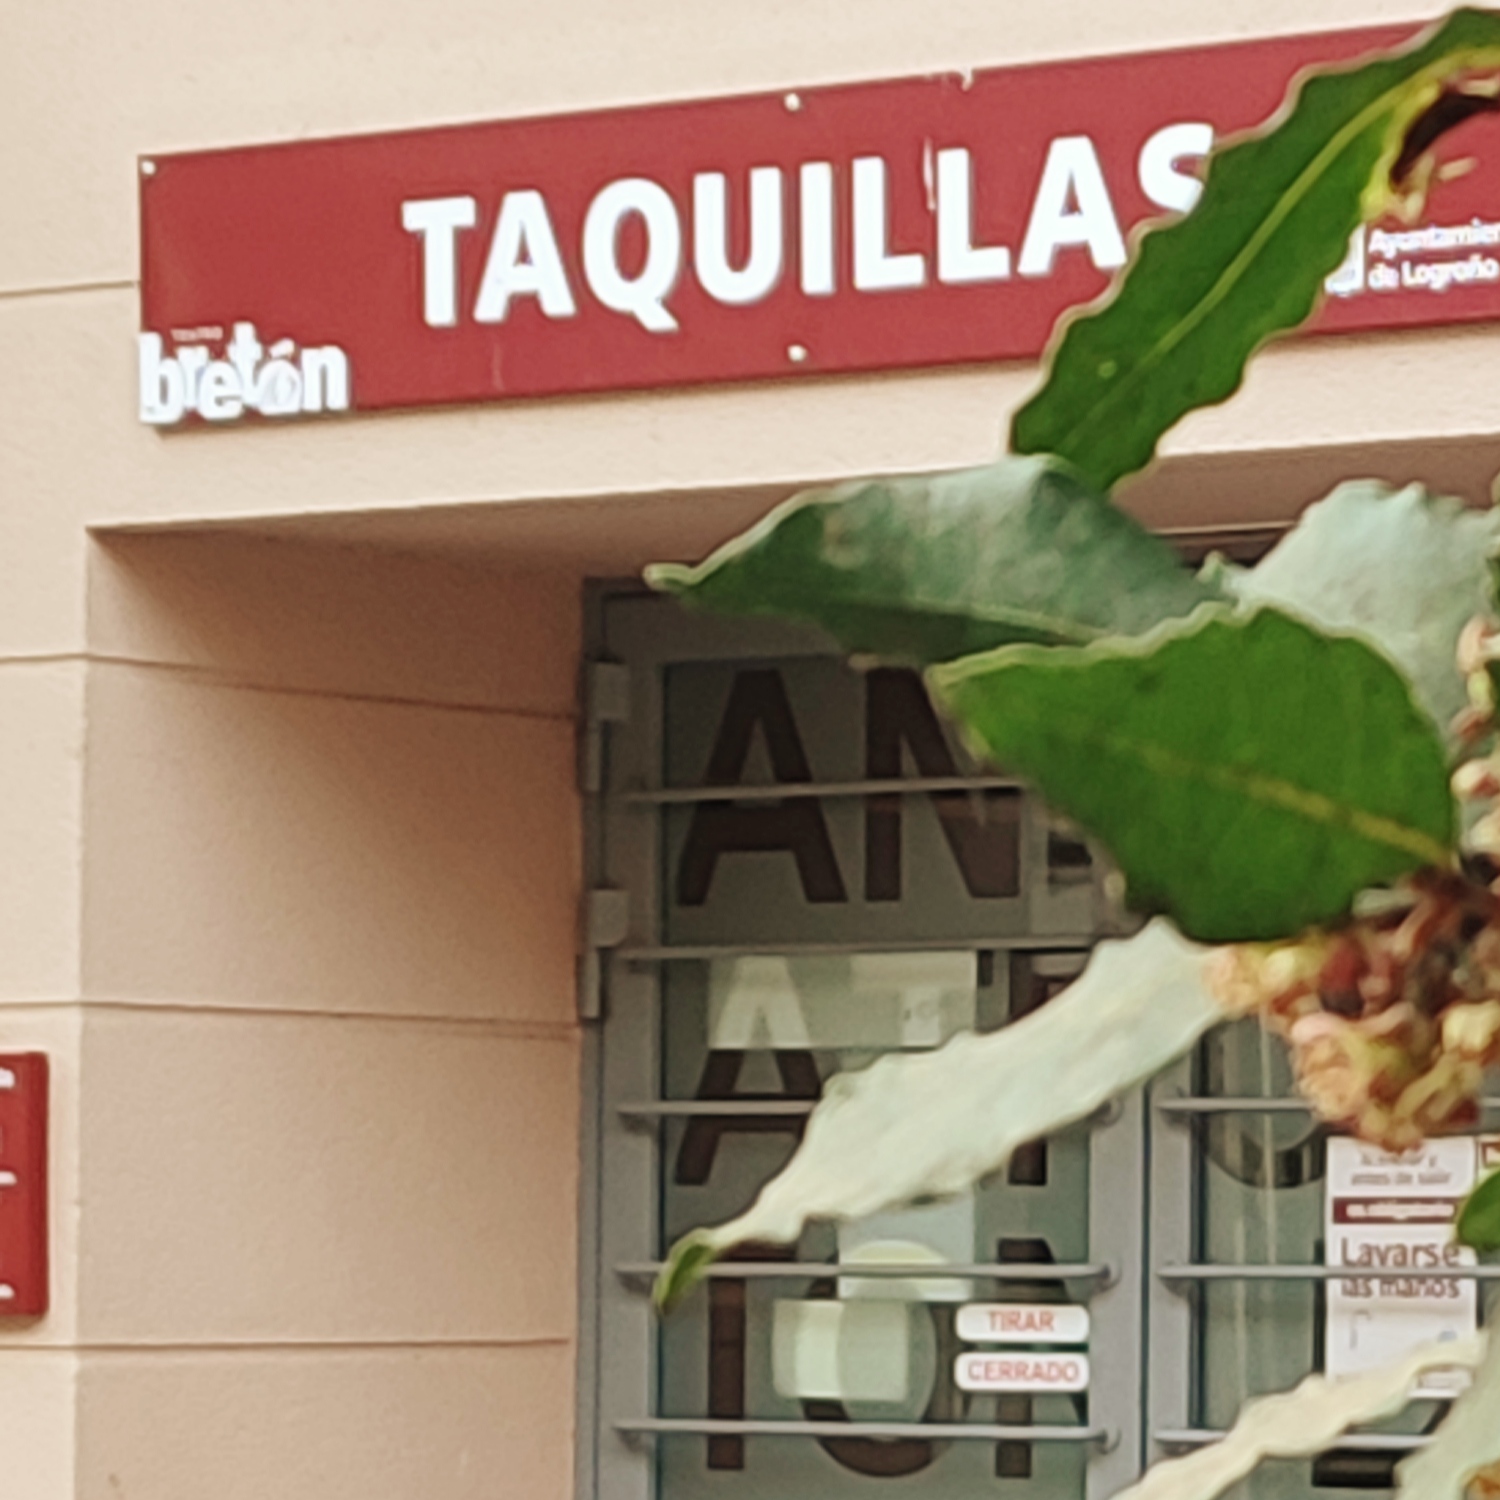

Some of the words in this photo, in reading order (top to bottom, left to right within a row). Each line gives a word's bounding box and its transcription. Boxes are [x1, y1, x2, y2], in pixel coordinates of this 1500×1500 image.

[401, 122, 1214, 333] TAQUILLAS
[1368, 263, 1399, 288] de
[1402, 254, 1500, 290] Logroño
[139, 321, 348, 424] bretón
[1341, 1236, 1460, 1268] Lavarse
[1379, 1272, 1461, 1299] manos
[988, 1310, 1055, 1332] TIRAR
[967, 1360, 1080, 1381] CERRADO
